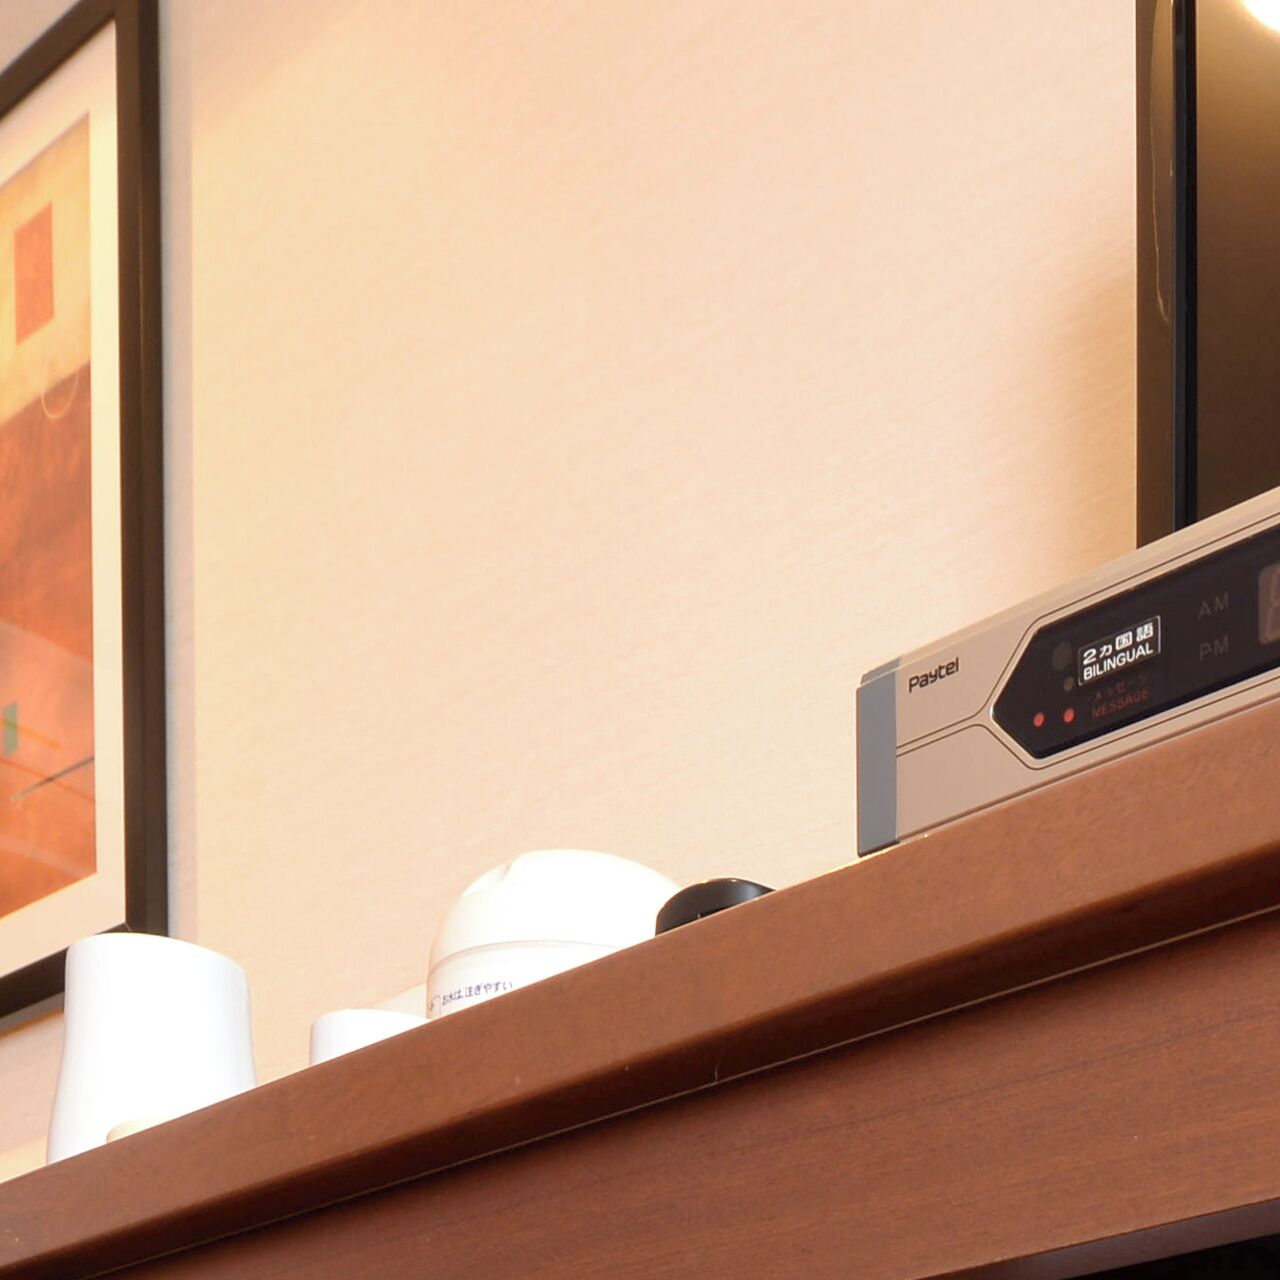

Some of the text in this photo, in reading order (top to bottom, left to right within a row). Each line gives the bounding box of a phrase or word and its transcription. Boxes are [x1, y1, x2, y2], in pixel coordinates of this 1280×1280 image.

[1198, 593, 1229, 619] AM
[1082, 642, 1154, 681] BILINGUAL
[1200, 635, 1229, 661] PM
[908, 656, 959, 694] Paytel
[1091, 689, 1149, 719] MESSAGE
